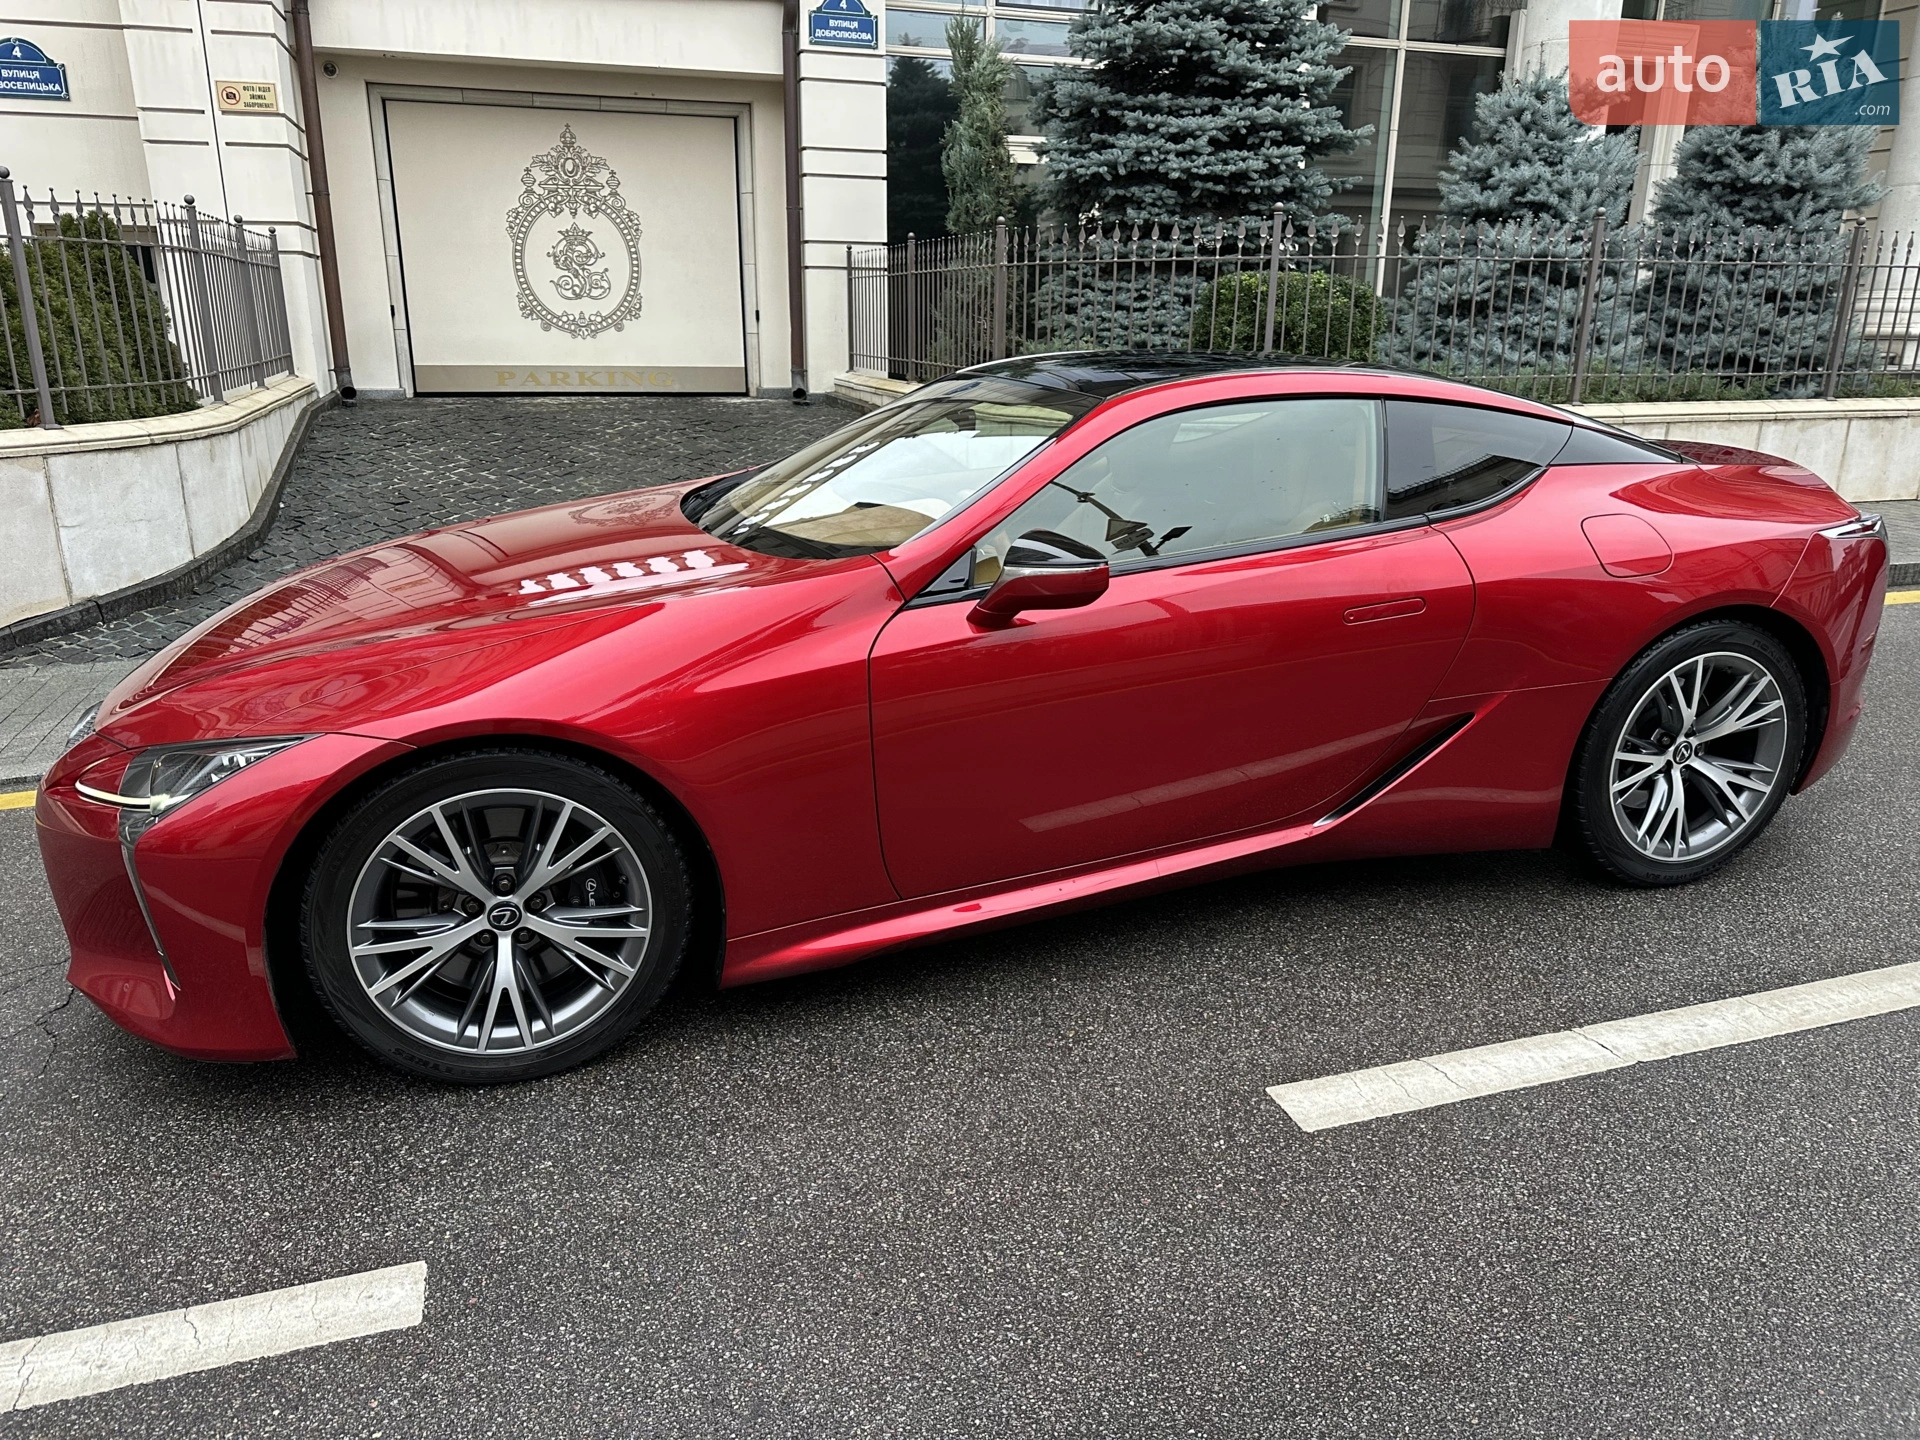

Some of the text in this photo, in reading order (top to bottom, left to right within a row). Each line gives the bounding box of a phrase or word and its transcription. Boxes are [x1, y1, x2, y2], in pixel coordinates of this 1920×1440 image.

[839, 0, 847, 9] 4
[829, 19, 858, 29] ВУЛИЦЯ
[815, 29, 872, 40] ДОБРОЛЮБОВА
[12, 46, 22, 58] 4
[1, 69, 40, 79] ВУЛИЦЯ
[242, 85, 255, 93] ФОТО
[495, 370, 676, 387] PARKING
